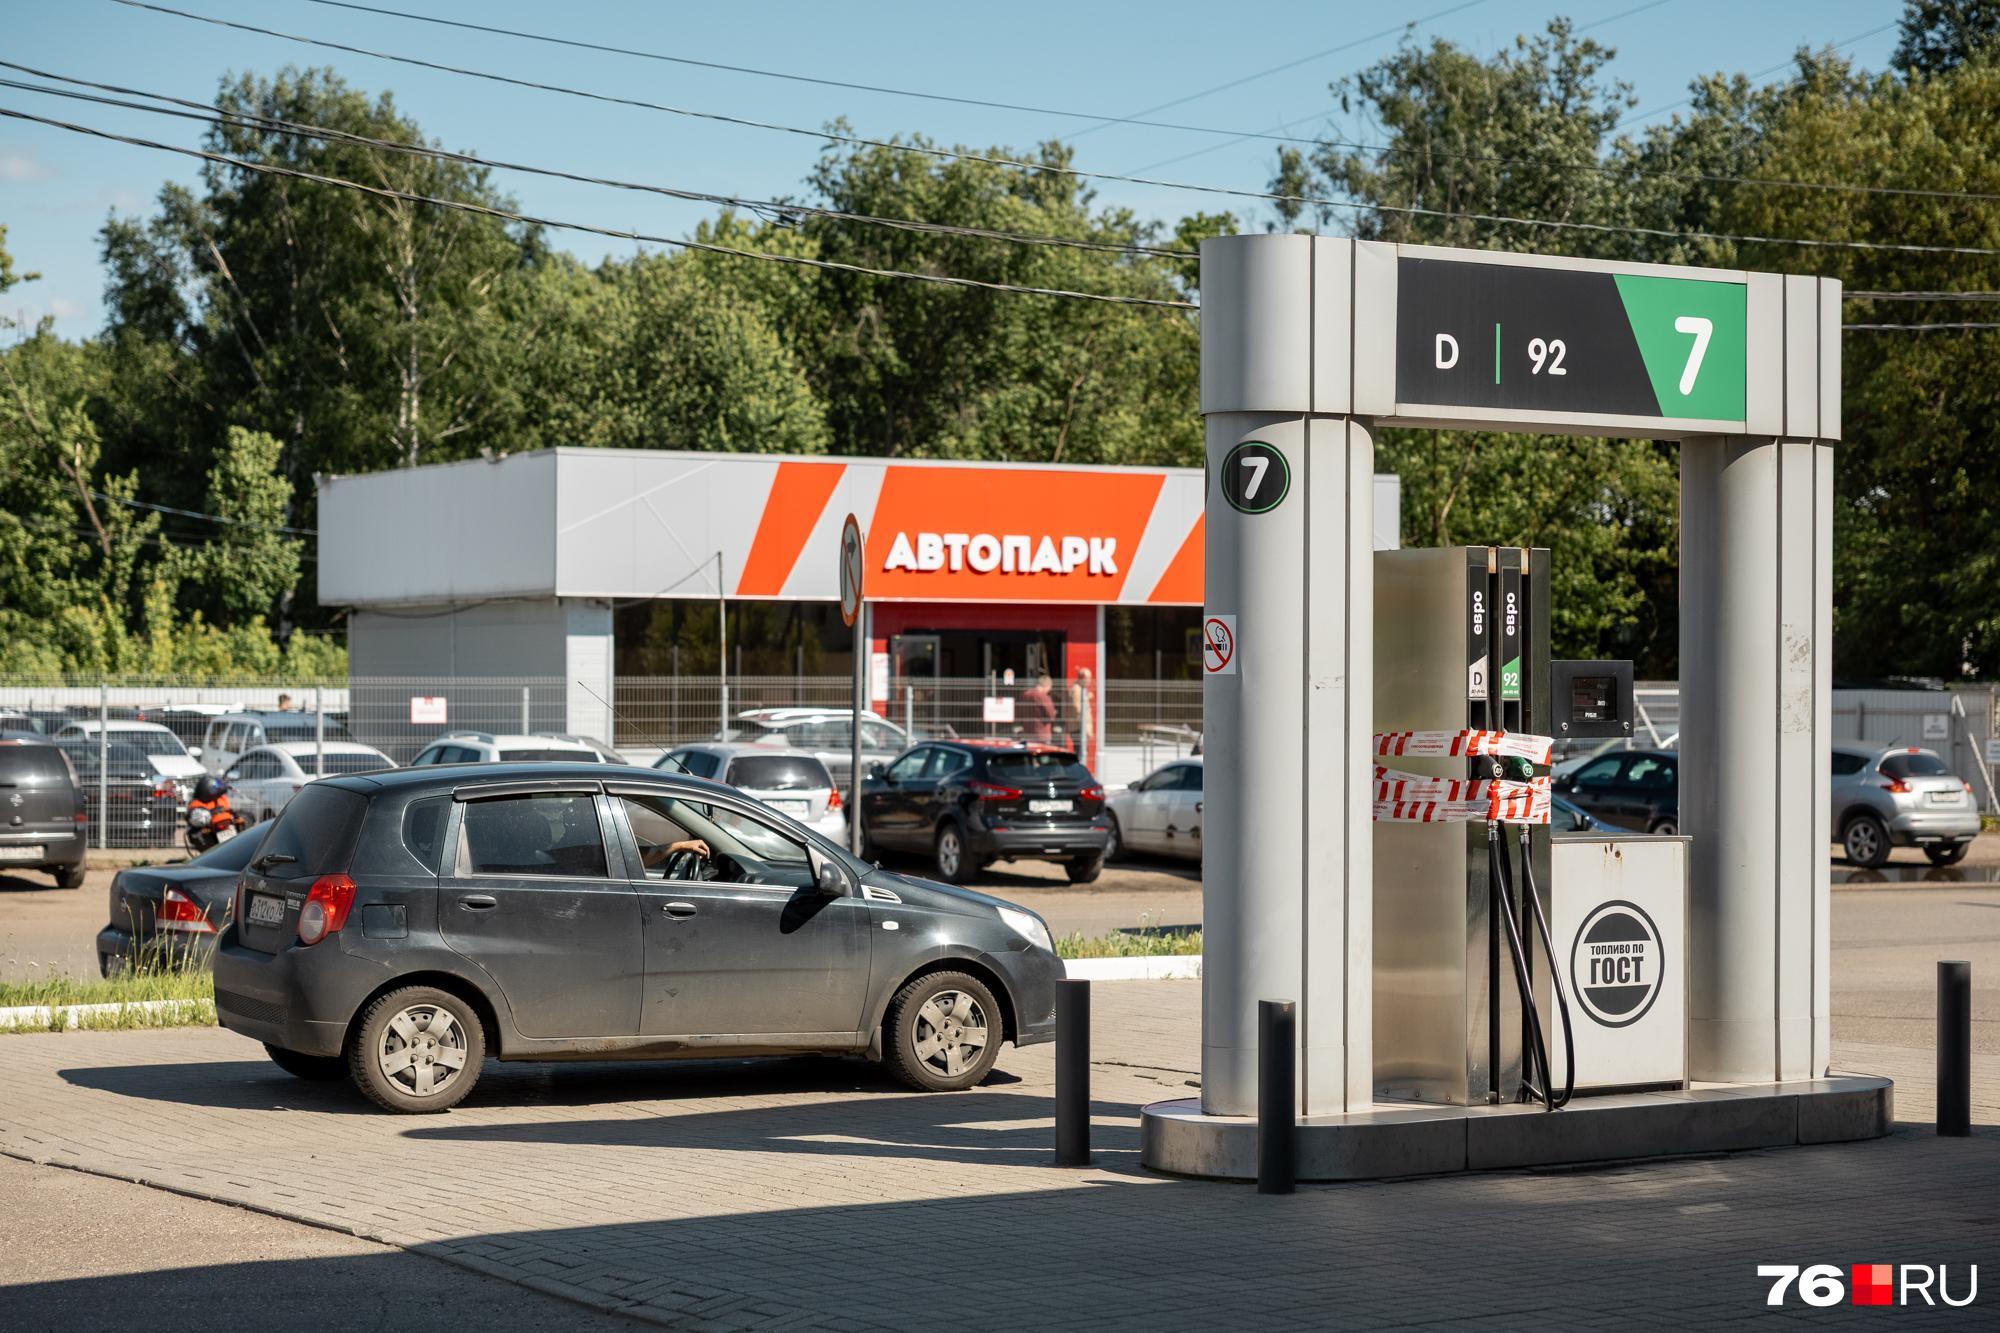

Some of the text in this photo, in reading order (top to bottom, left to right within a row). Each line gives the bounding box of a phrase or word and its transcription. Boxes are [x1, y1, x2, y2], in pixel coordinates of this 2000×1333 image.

[1435, 333, 1567, 375] D 92
[1675, 316, 1713, 395] 7
[1240, 457, 1269, 500] 7
[883, 532, 1118, 577] АВТОПАРК
[1473, 591, 1485, 635] евро
[1506, 592, 1518, 636] евро
[1474, 672, 1482, 685] D
[1503, 672, 1518, 686] 92
[1591, 943, 1644, 955] ТОПЛИВО ПО
[1590, 956, 1644, 985] ГОСТ
